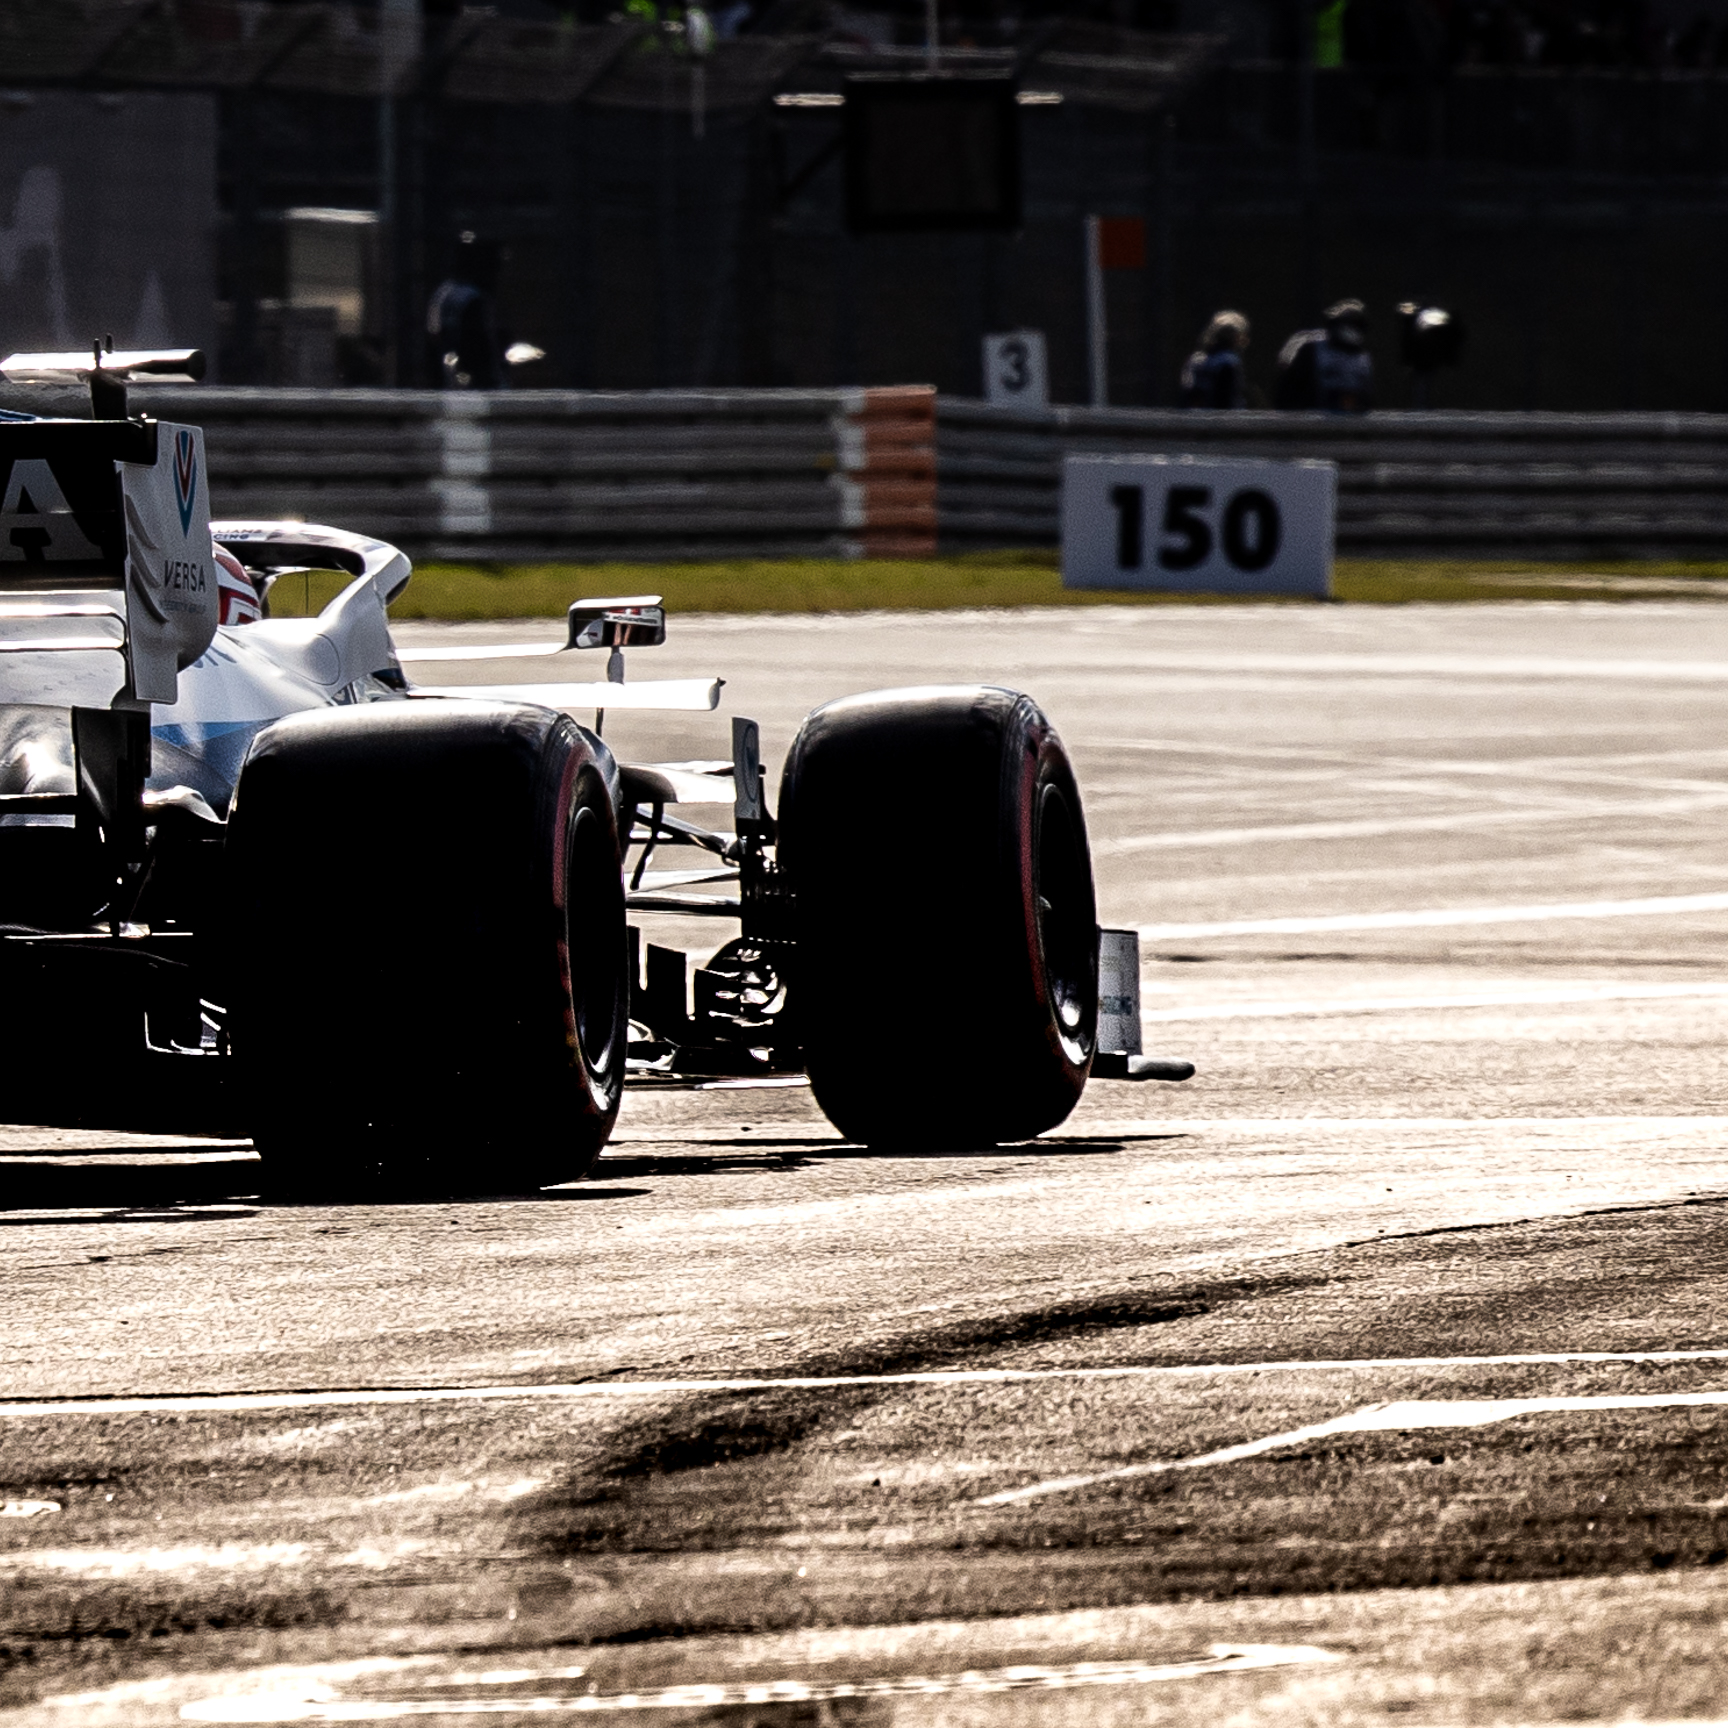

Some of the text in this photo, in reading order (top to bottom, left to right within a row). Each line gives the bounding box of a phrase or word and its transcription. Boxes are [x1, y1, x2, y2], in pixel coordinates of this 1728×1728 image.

[1001, 341, 1028, 390] 3
[1112, 486, 1278, 569] 150
[164, 560, 206, 592] VERSA
